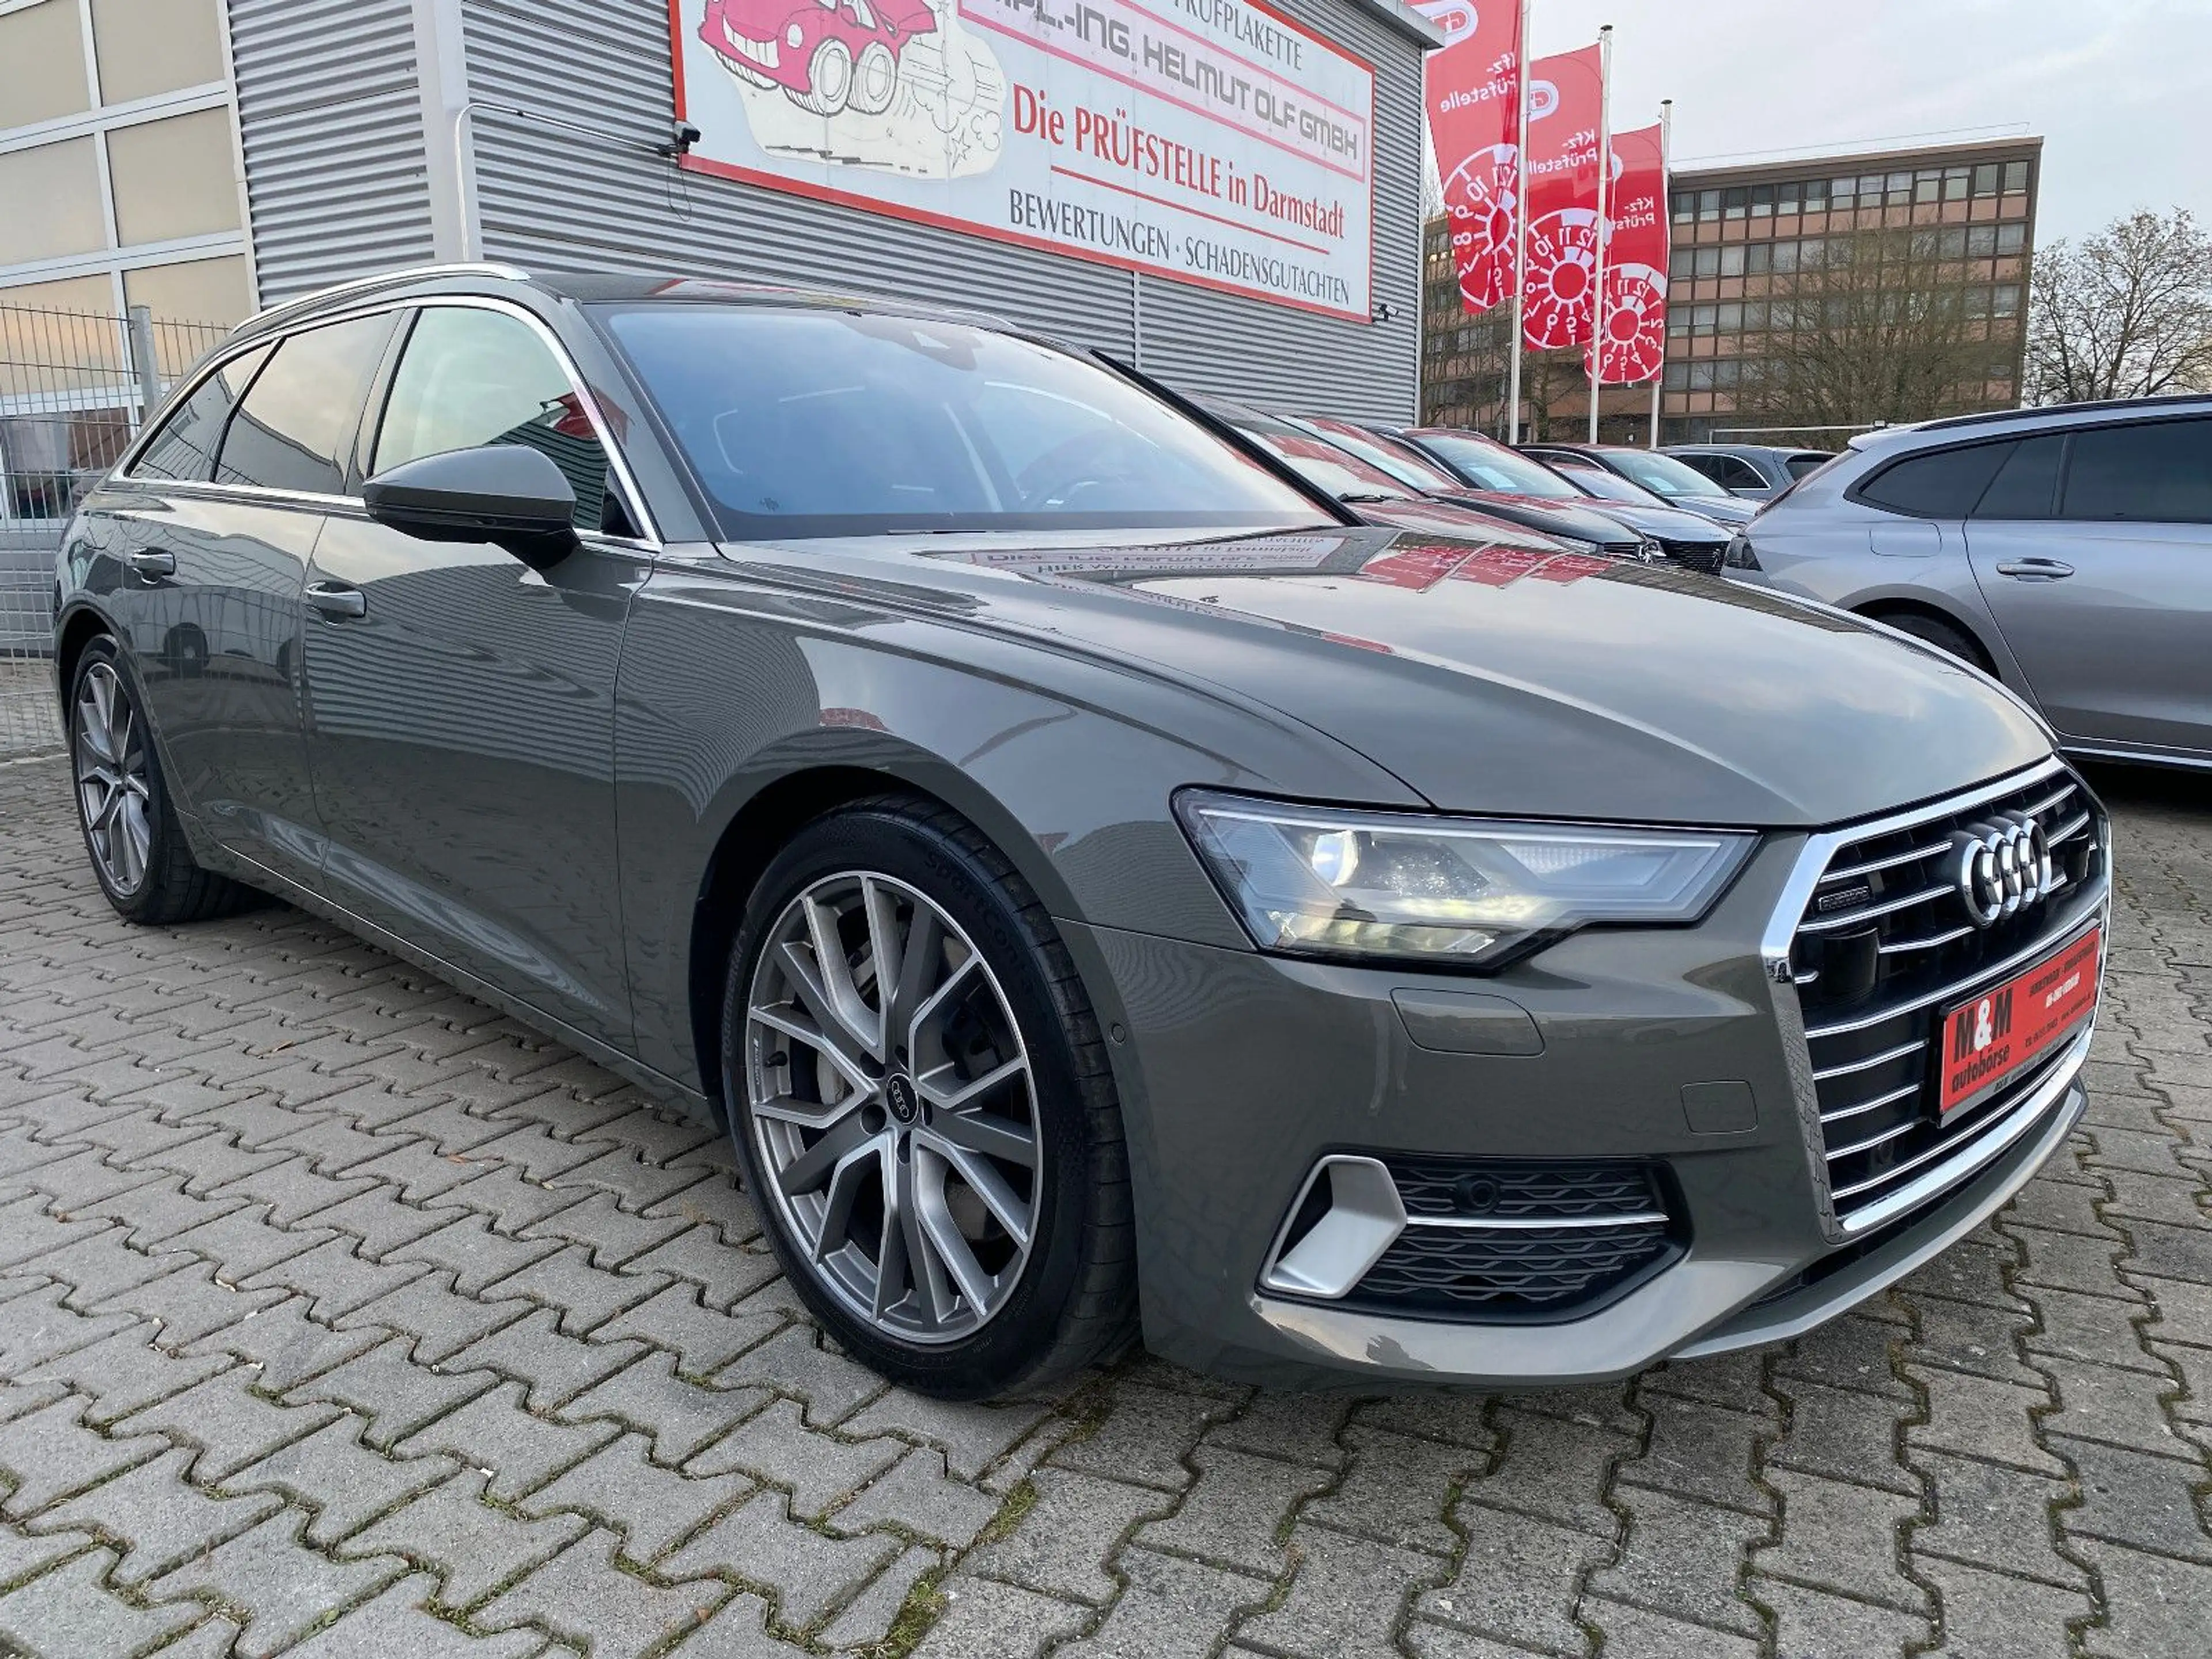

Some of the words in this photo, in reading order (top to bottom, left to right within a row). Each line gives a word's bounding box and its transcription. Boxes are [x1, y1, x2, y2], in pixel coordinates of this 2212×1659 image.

[1143, 35, 1250, 110] HELMUT
[1255, 88, 1296, 128] OLF
[1013, 83, 1064, 145] Die
[1075, 106, 1221, 198] PRÜFSTELLE
[1228, 161, 1247, 206] in
[1253, 174, 1344, 240] Darmstadt
[1010, 188, 1170, 260] BEWERTUNGEN
[1185, 236, 1349, 305] SCHADENSGUTACHTEN
[1951, 1043, 2010, 1093] autobörse
[1953, 987, 2014, 1064] M&M
